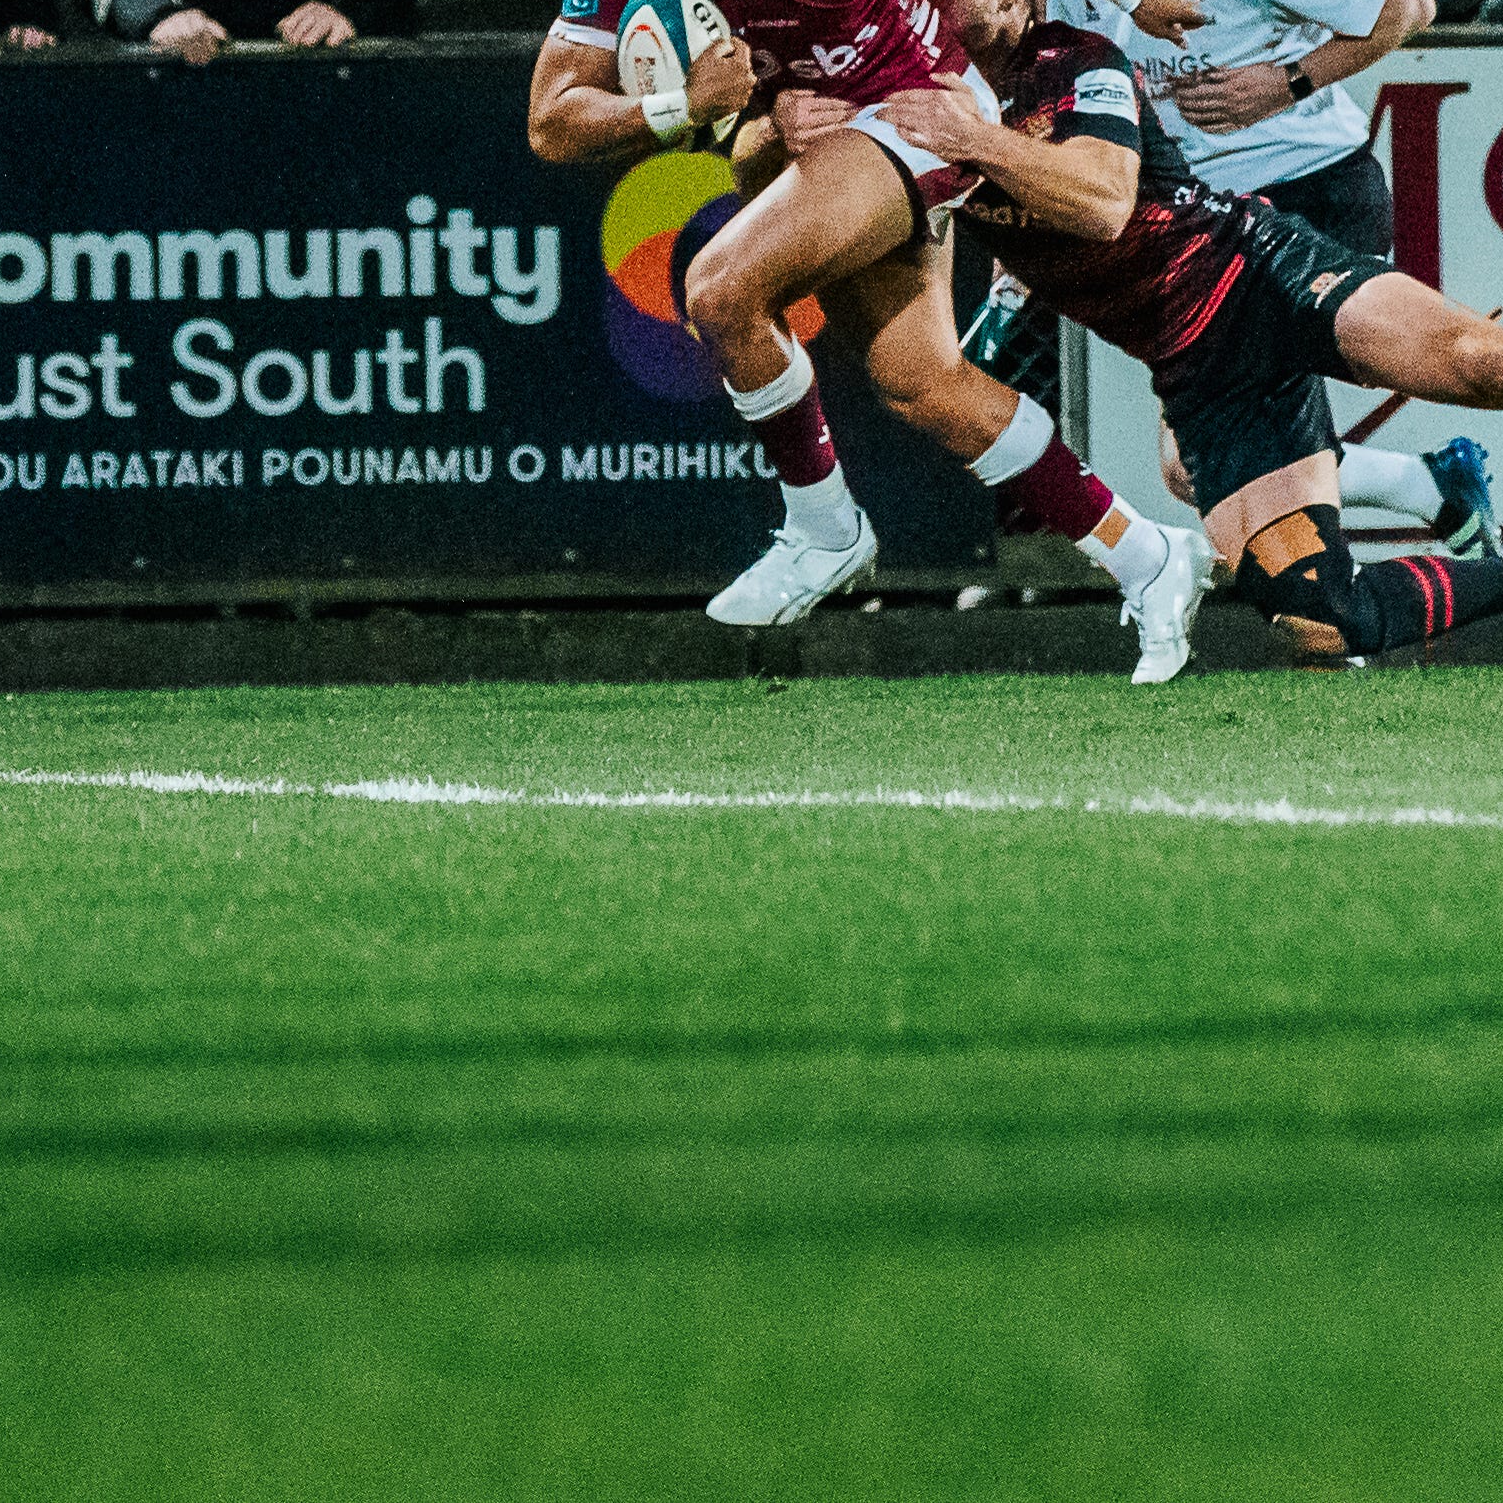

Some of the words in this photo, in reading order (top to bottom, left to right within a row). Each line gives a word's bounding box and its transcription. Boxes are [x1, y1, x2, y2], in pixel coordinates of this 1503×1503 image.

[169, 316, 486, 419] South
[60, 449, 245, 489] ARATAKI
[261, 446, 494, 487] POUNAMU
[506, 443, 547, 484] O
[560, 441, 779, 482] MURIHIKU
